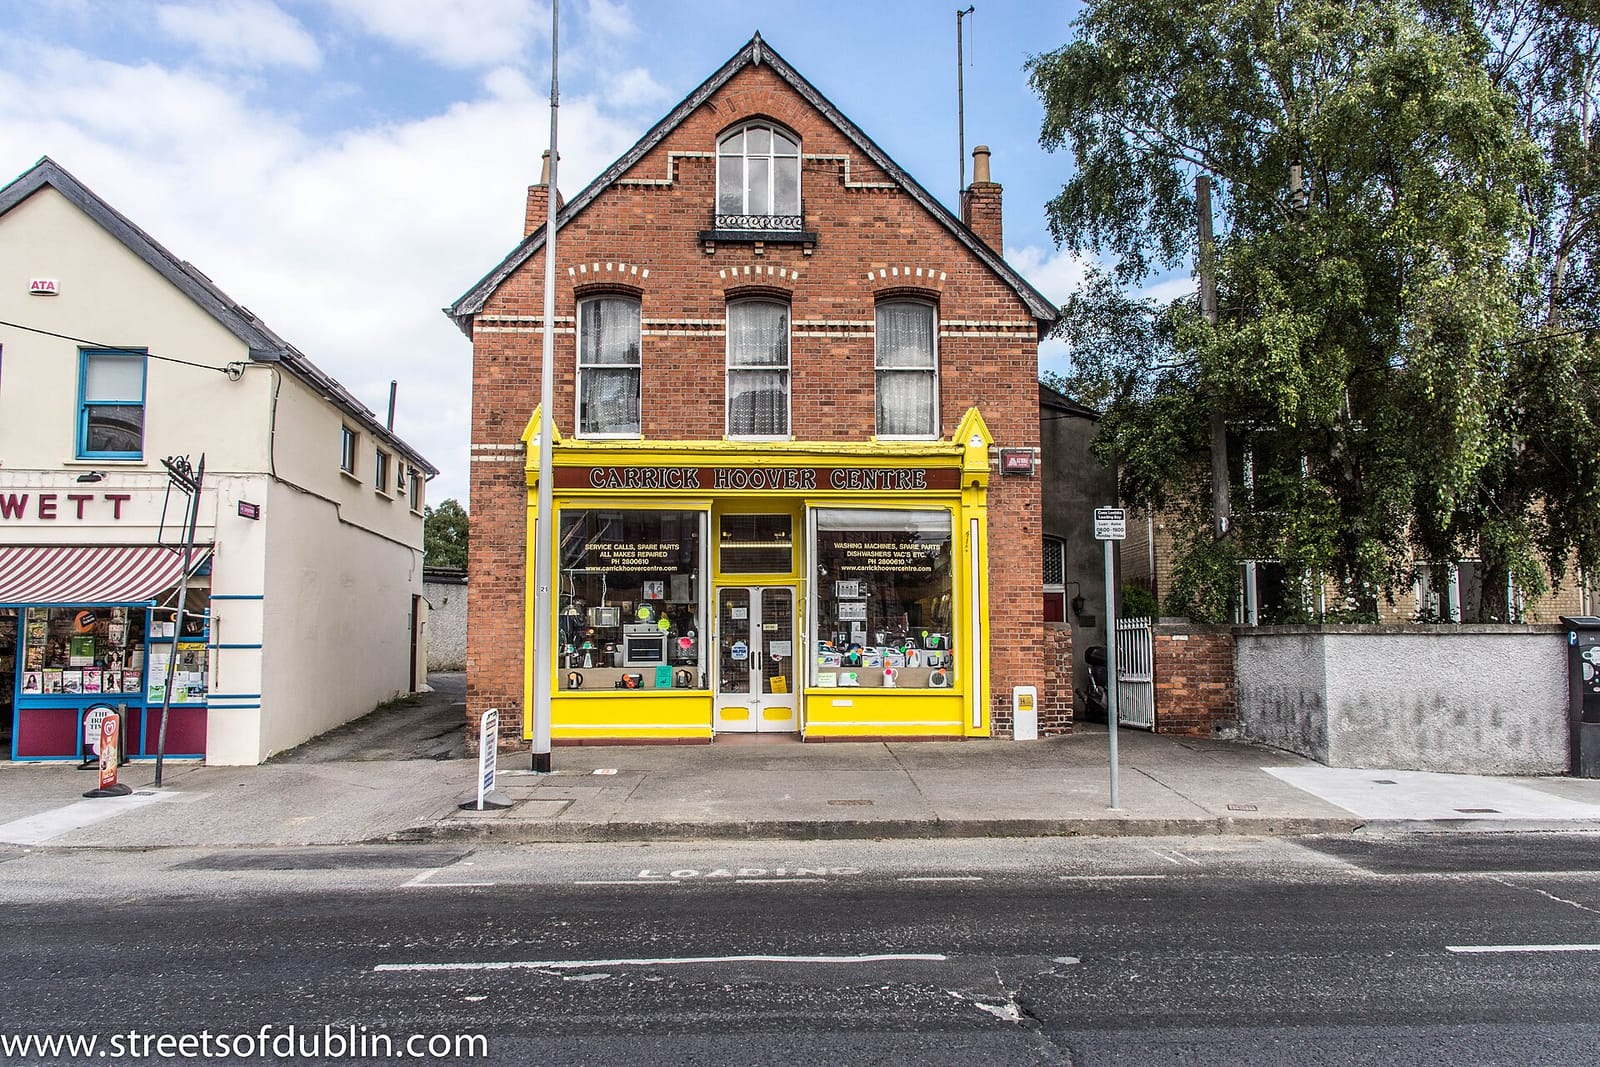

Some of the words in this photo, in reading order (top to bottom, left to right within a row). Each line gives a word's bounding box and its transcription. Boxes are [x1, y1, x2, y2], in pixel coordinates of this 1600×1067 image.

[31, 281, 55, 290] ATA
[589, 468, 701, 489] CARRICK
[713, 468, 816, 490] HOOVER
[830, 468, 927, 490] CENTRE
[0, 493, 131, 520] WETT
[1570, 631, 1577, 645] P
[638, 867, 863, 878] LOADING
